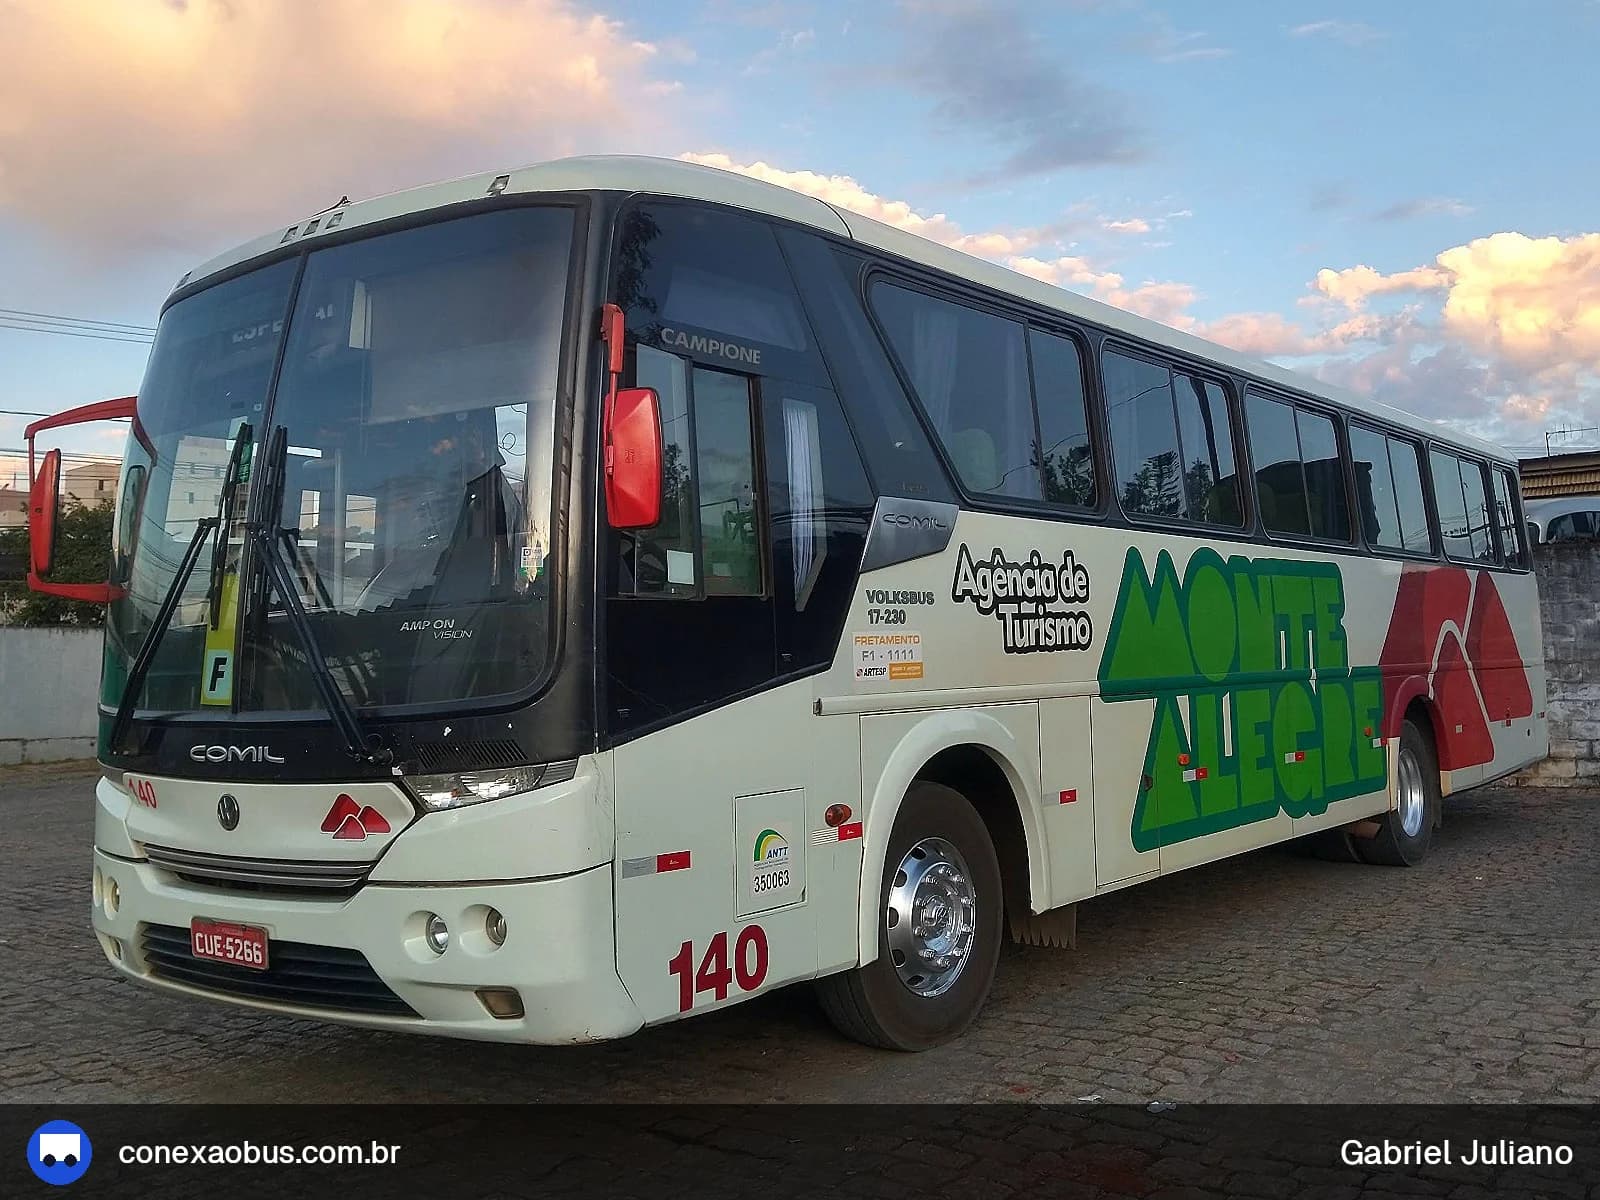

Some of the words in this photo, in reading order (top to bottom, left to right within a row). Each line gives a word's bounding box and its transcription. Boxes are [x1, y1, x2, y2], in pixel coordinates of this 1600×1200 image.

[660, 327, 761, 365] CAMPIONE
[882, 513, 947, 529] COMIL
[954, 545, 1057, 612] Agência
[1059, 552, 1088, 600] de
[866, 589, 935, 606] VOLKSBUS
[400, 619, 430, 632] AMP
[433, 618, 455, 629] ON
[868, 609, 907, 625] 17-230
[998, 602, 1091, 650] Turismo
[1103, 555, 1347, 685] MONTE
[433, 630, 473, 639] VISION
[854, 635, 920, 645] FRETAMENTO
[861, 650, 875, 662] F1
[887, 649, 914, 660] 1111
[208, 656, 228, 692] F
[863, 667, 887, 677] ARTESP
[190, 744, 285, 763] COMIL
[1135, 674, 1387, 843] ALEGRE
[128, 779, 157, 809] 140
[766, 846, 789, 860] ANTT
[753, 869, 790, 893] 350063
[668, 924, 769, 1012] 140
